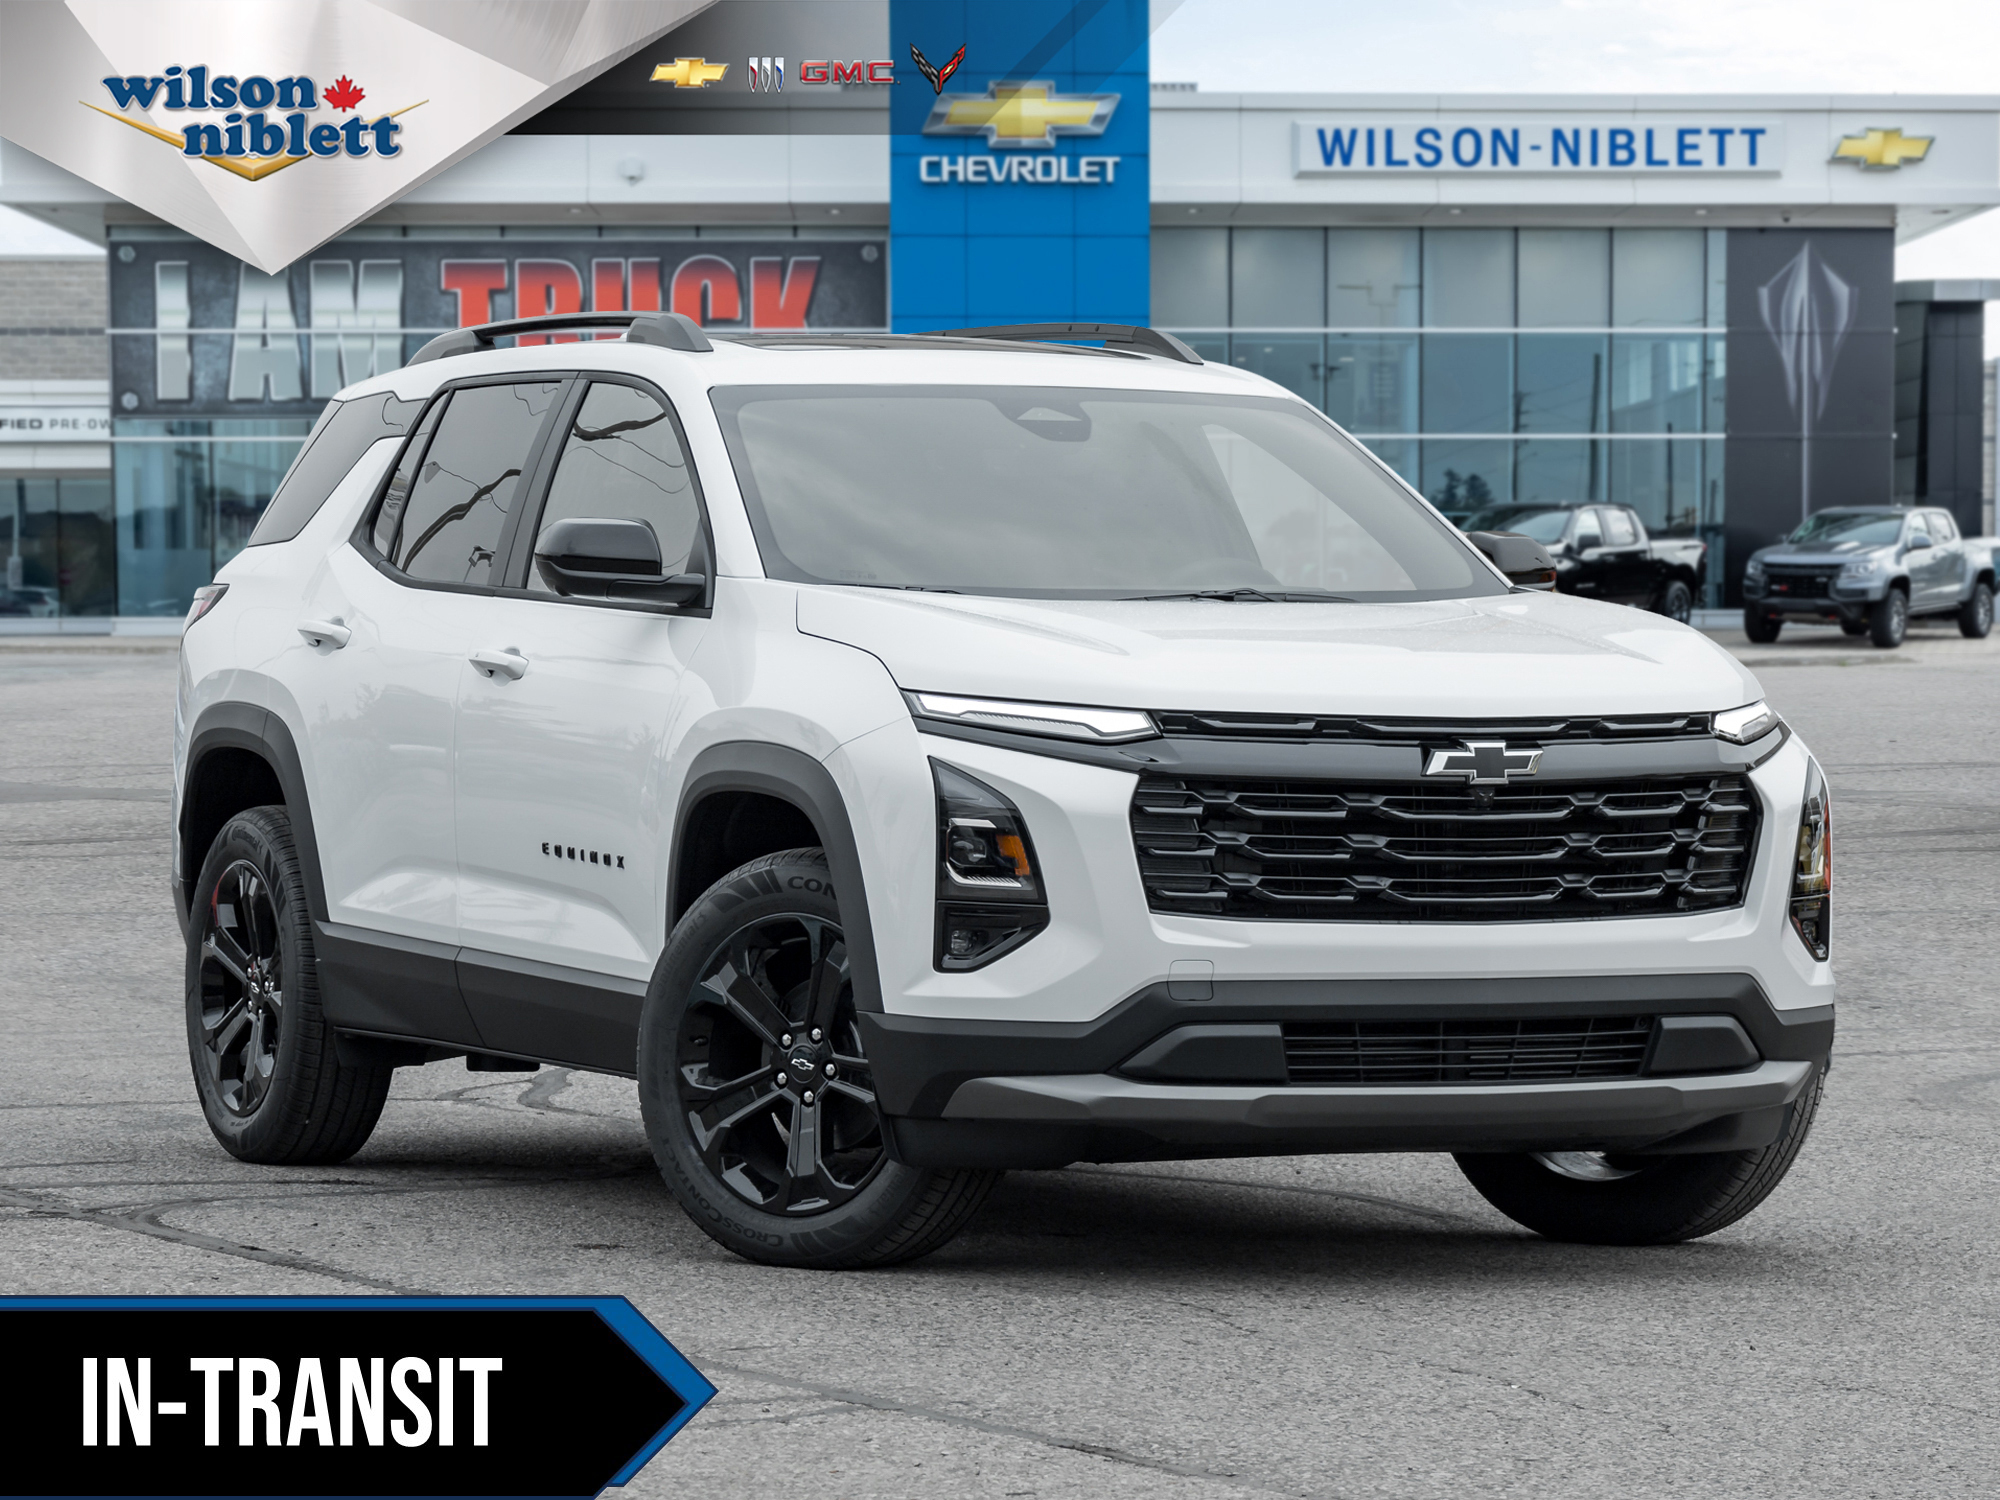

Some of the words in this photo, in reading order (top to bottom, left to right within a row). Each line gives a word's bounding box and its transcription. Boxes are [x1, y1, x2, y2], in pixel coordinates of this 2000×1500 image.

[919, 155, 1121, 183] CHEVROLET
[155, 260, 190, 400] I
[228, 259, 403, 400] AM
[541, 842, 625, 870] EQUINOX
